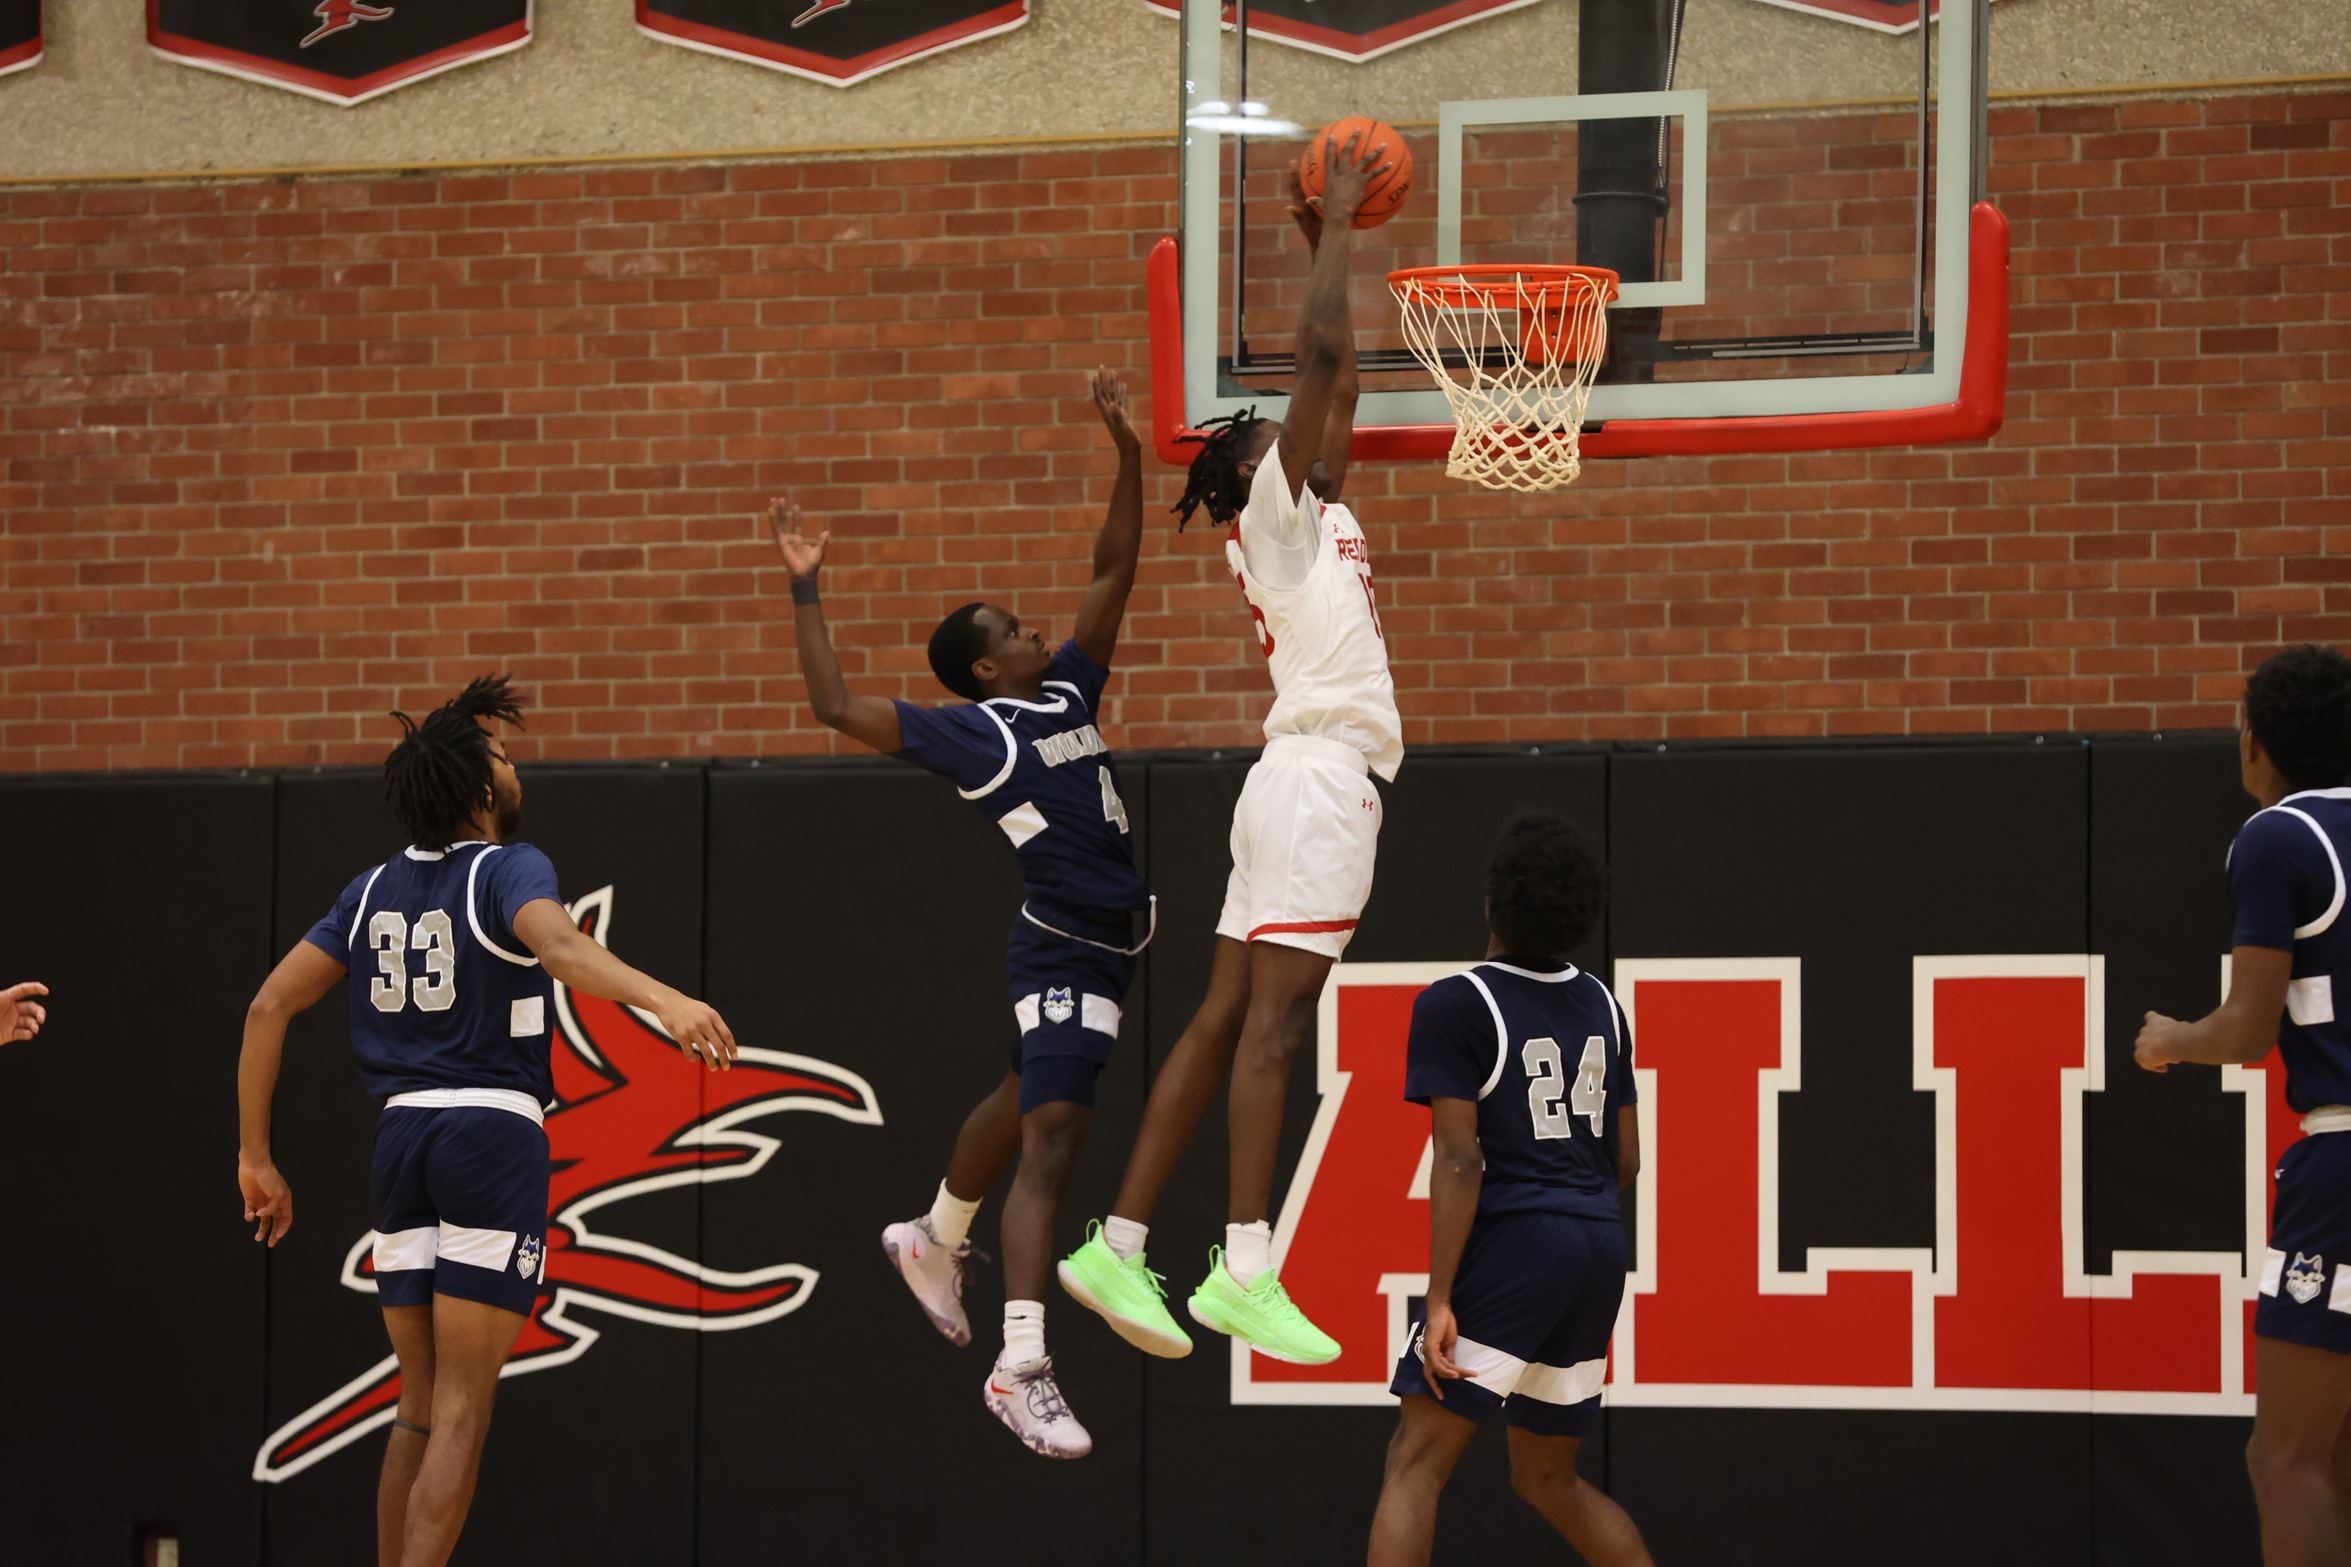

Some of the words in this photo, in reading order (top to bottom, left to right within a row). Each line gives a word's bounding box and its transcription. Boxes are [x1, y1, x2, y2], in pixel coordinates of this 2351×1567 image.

[1098, 765, 1130, 834] 4
[369, 908, 456, 1012] 33
[1521, 1035, 1607, 1140] 24
[1231, 953, 2309, 1417] ALL
